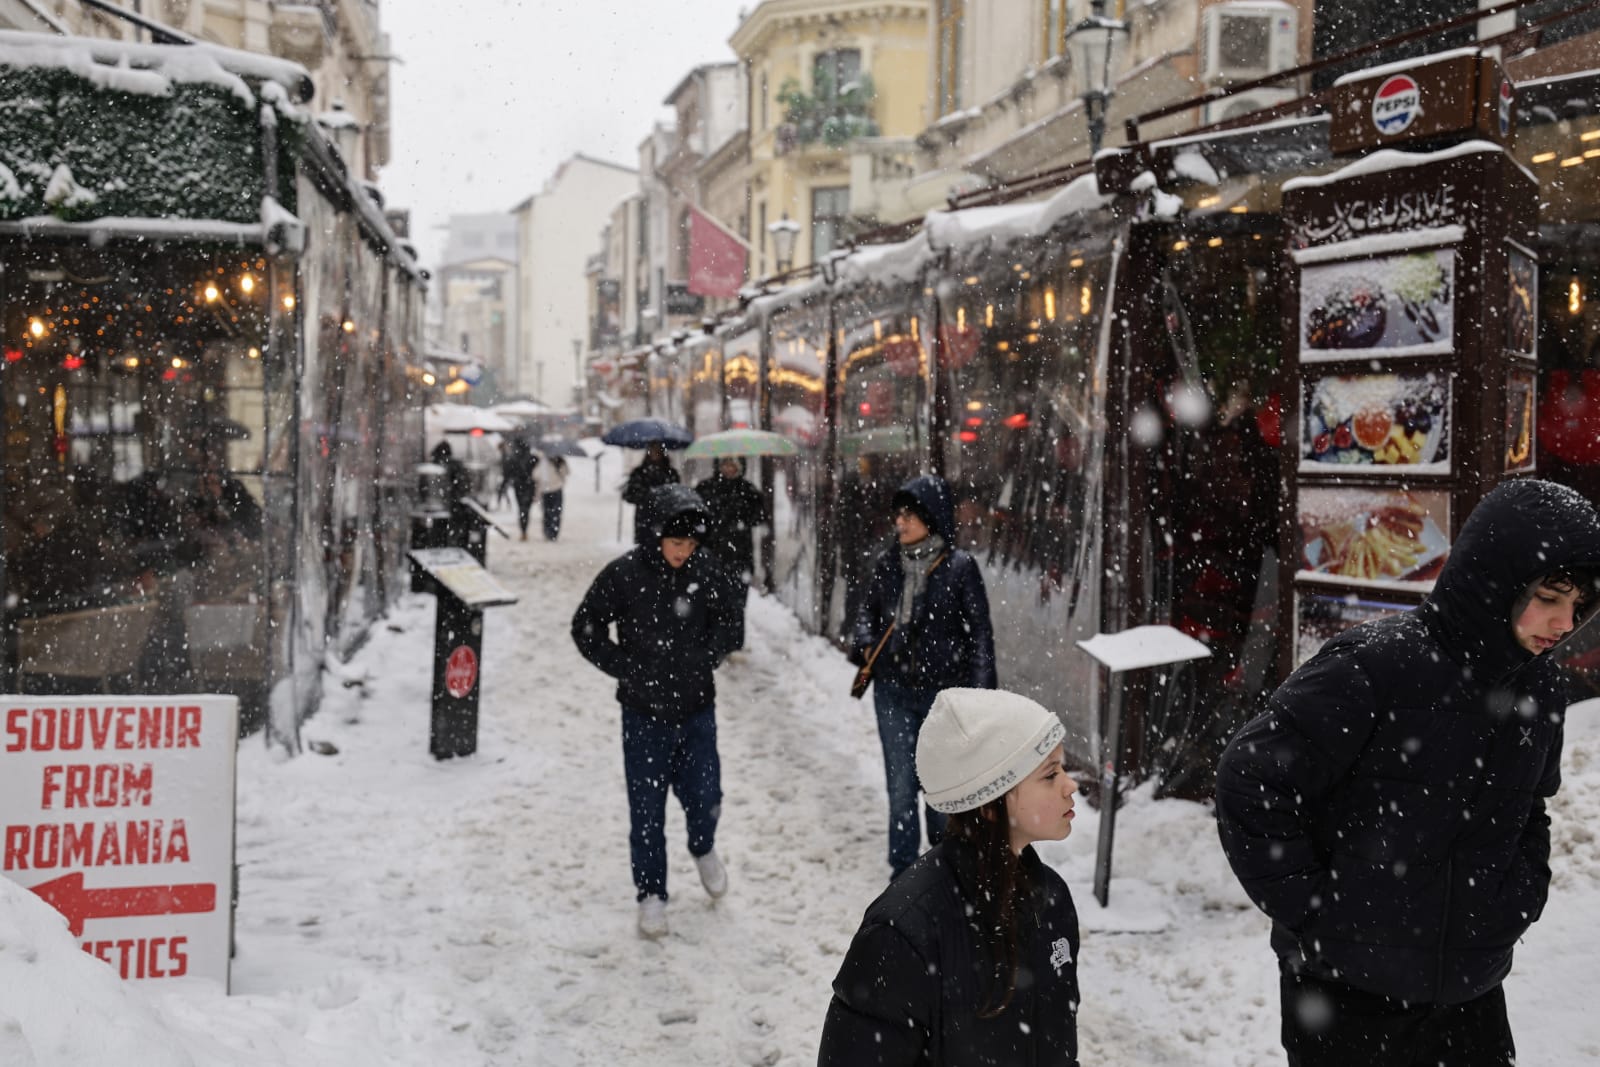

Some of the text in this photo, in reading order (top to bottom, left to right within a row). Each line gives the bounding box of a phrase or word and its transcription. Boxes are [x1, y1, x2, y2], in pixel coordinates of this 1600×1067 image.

[1375, 97, 1416, 114] PEPSI
[5, 706, 202, 752] SOUVENIR
[41, 761, 153, 809] FROM
[3, 819, 190, 870] ROMANIA
[81, 936, 188, 980] ETICS
